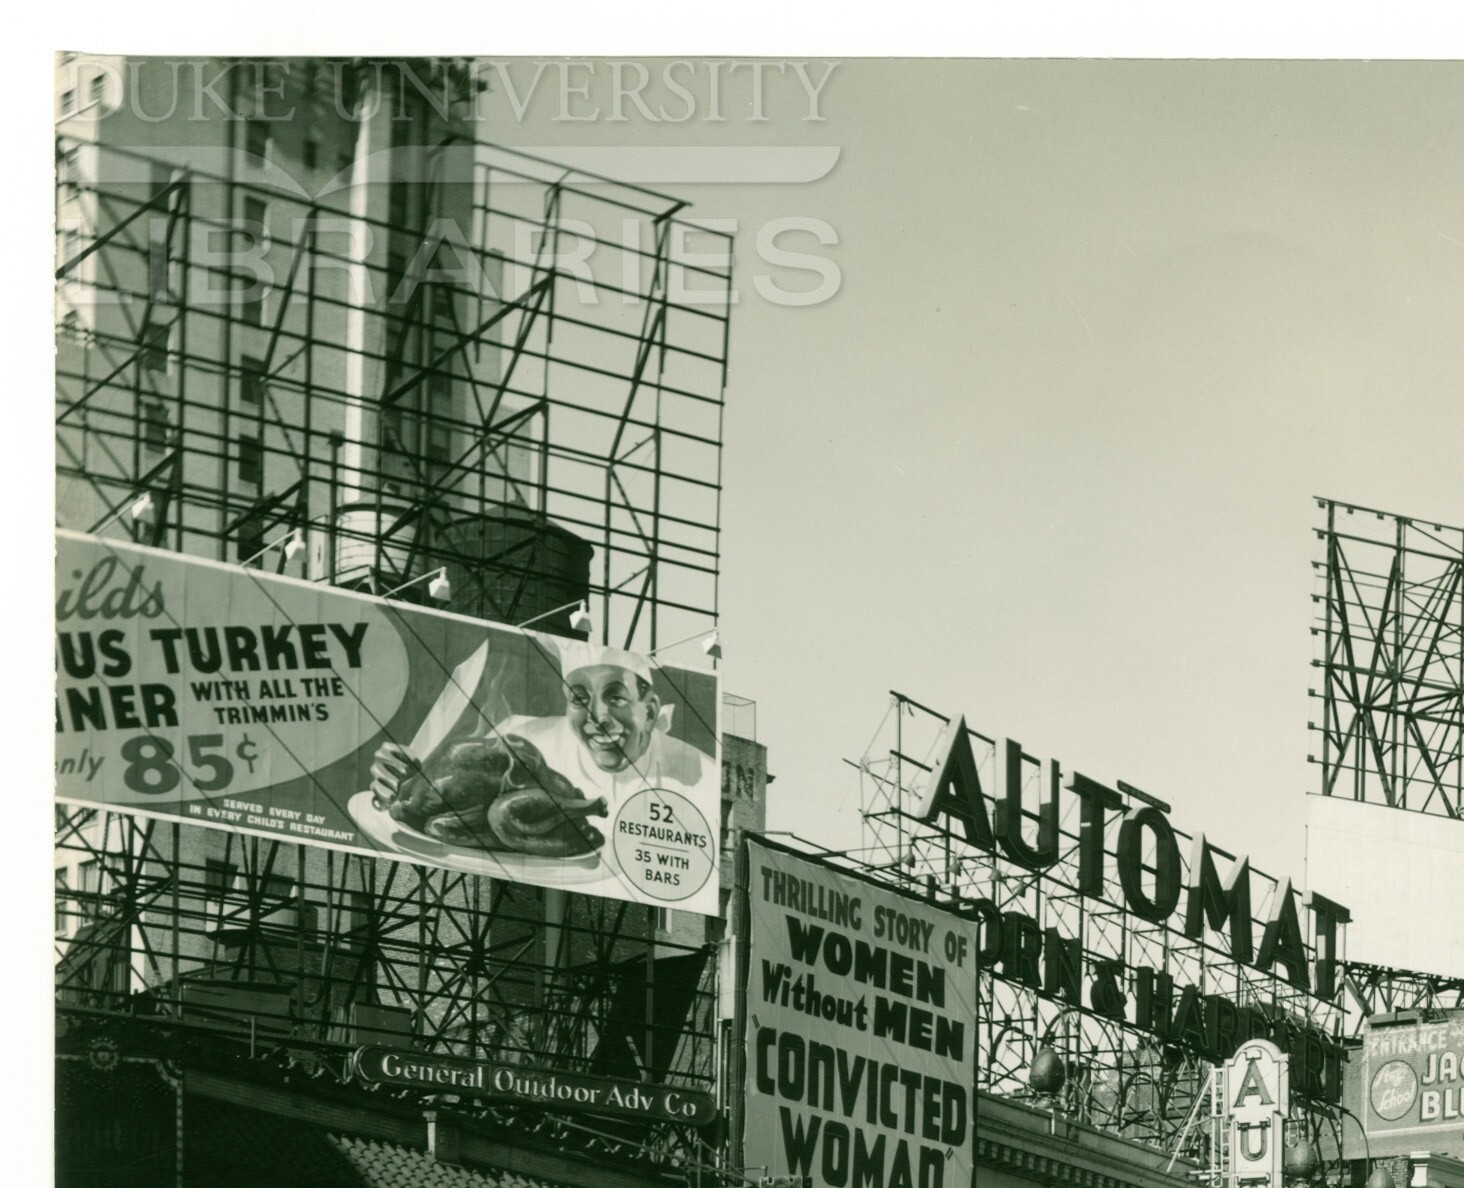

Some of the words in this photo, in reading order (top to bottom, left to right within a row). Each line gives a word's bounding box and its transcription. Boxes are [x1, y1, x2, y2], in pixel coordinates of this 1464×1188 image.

[150, 622, 369, 675] TURKEY
[190, 680, 250, 702] WITH
[259, 679, 297, 700] ALL
[300, 676, 344, 698] THE
[213, 702, 329, 725] TRIMMIN'S
[189, 804, 201, 815] IN
[206, 807, 242, 823] EVERY
[247, 814, 285, 831] CHILD'S
[289, 820, 354, 842] RESTAURANT
[223, 798, 263, 814] SERVED
[269, 806, 303, 821] EVERY
[306, 813, 326, 825] DAY
[649, 802, 674, 824] 52
[619, 820, 707, 849] RESTAURANTS
[635, 849, 651, 863] 35
[656, 852, 690, 871] WITH
[916, 712, 1353, 1001] AUTOMAT
[645, 869, 680, 886] BARS
[761, 865, 862, 931] THRILLING
[873, 904, 934, 955] STORY
[944, 930, 968, 969] OF
[785, 913, 946, 1009] WOMEN
[761, 958, 868, 1032] Without
[873, 994, 965, 1063] MEN
[1368, 1030, 1447, 1058] ENTRANCE
[381, 1053, 484, 1088] General
[494, 1068, 601, 1103] Outdoor
[606, 1085, 654, 1112] Adv
[664, 1093, 697, 1118] Co
